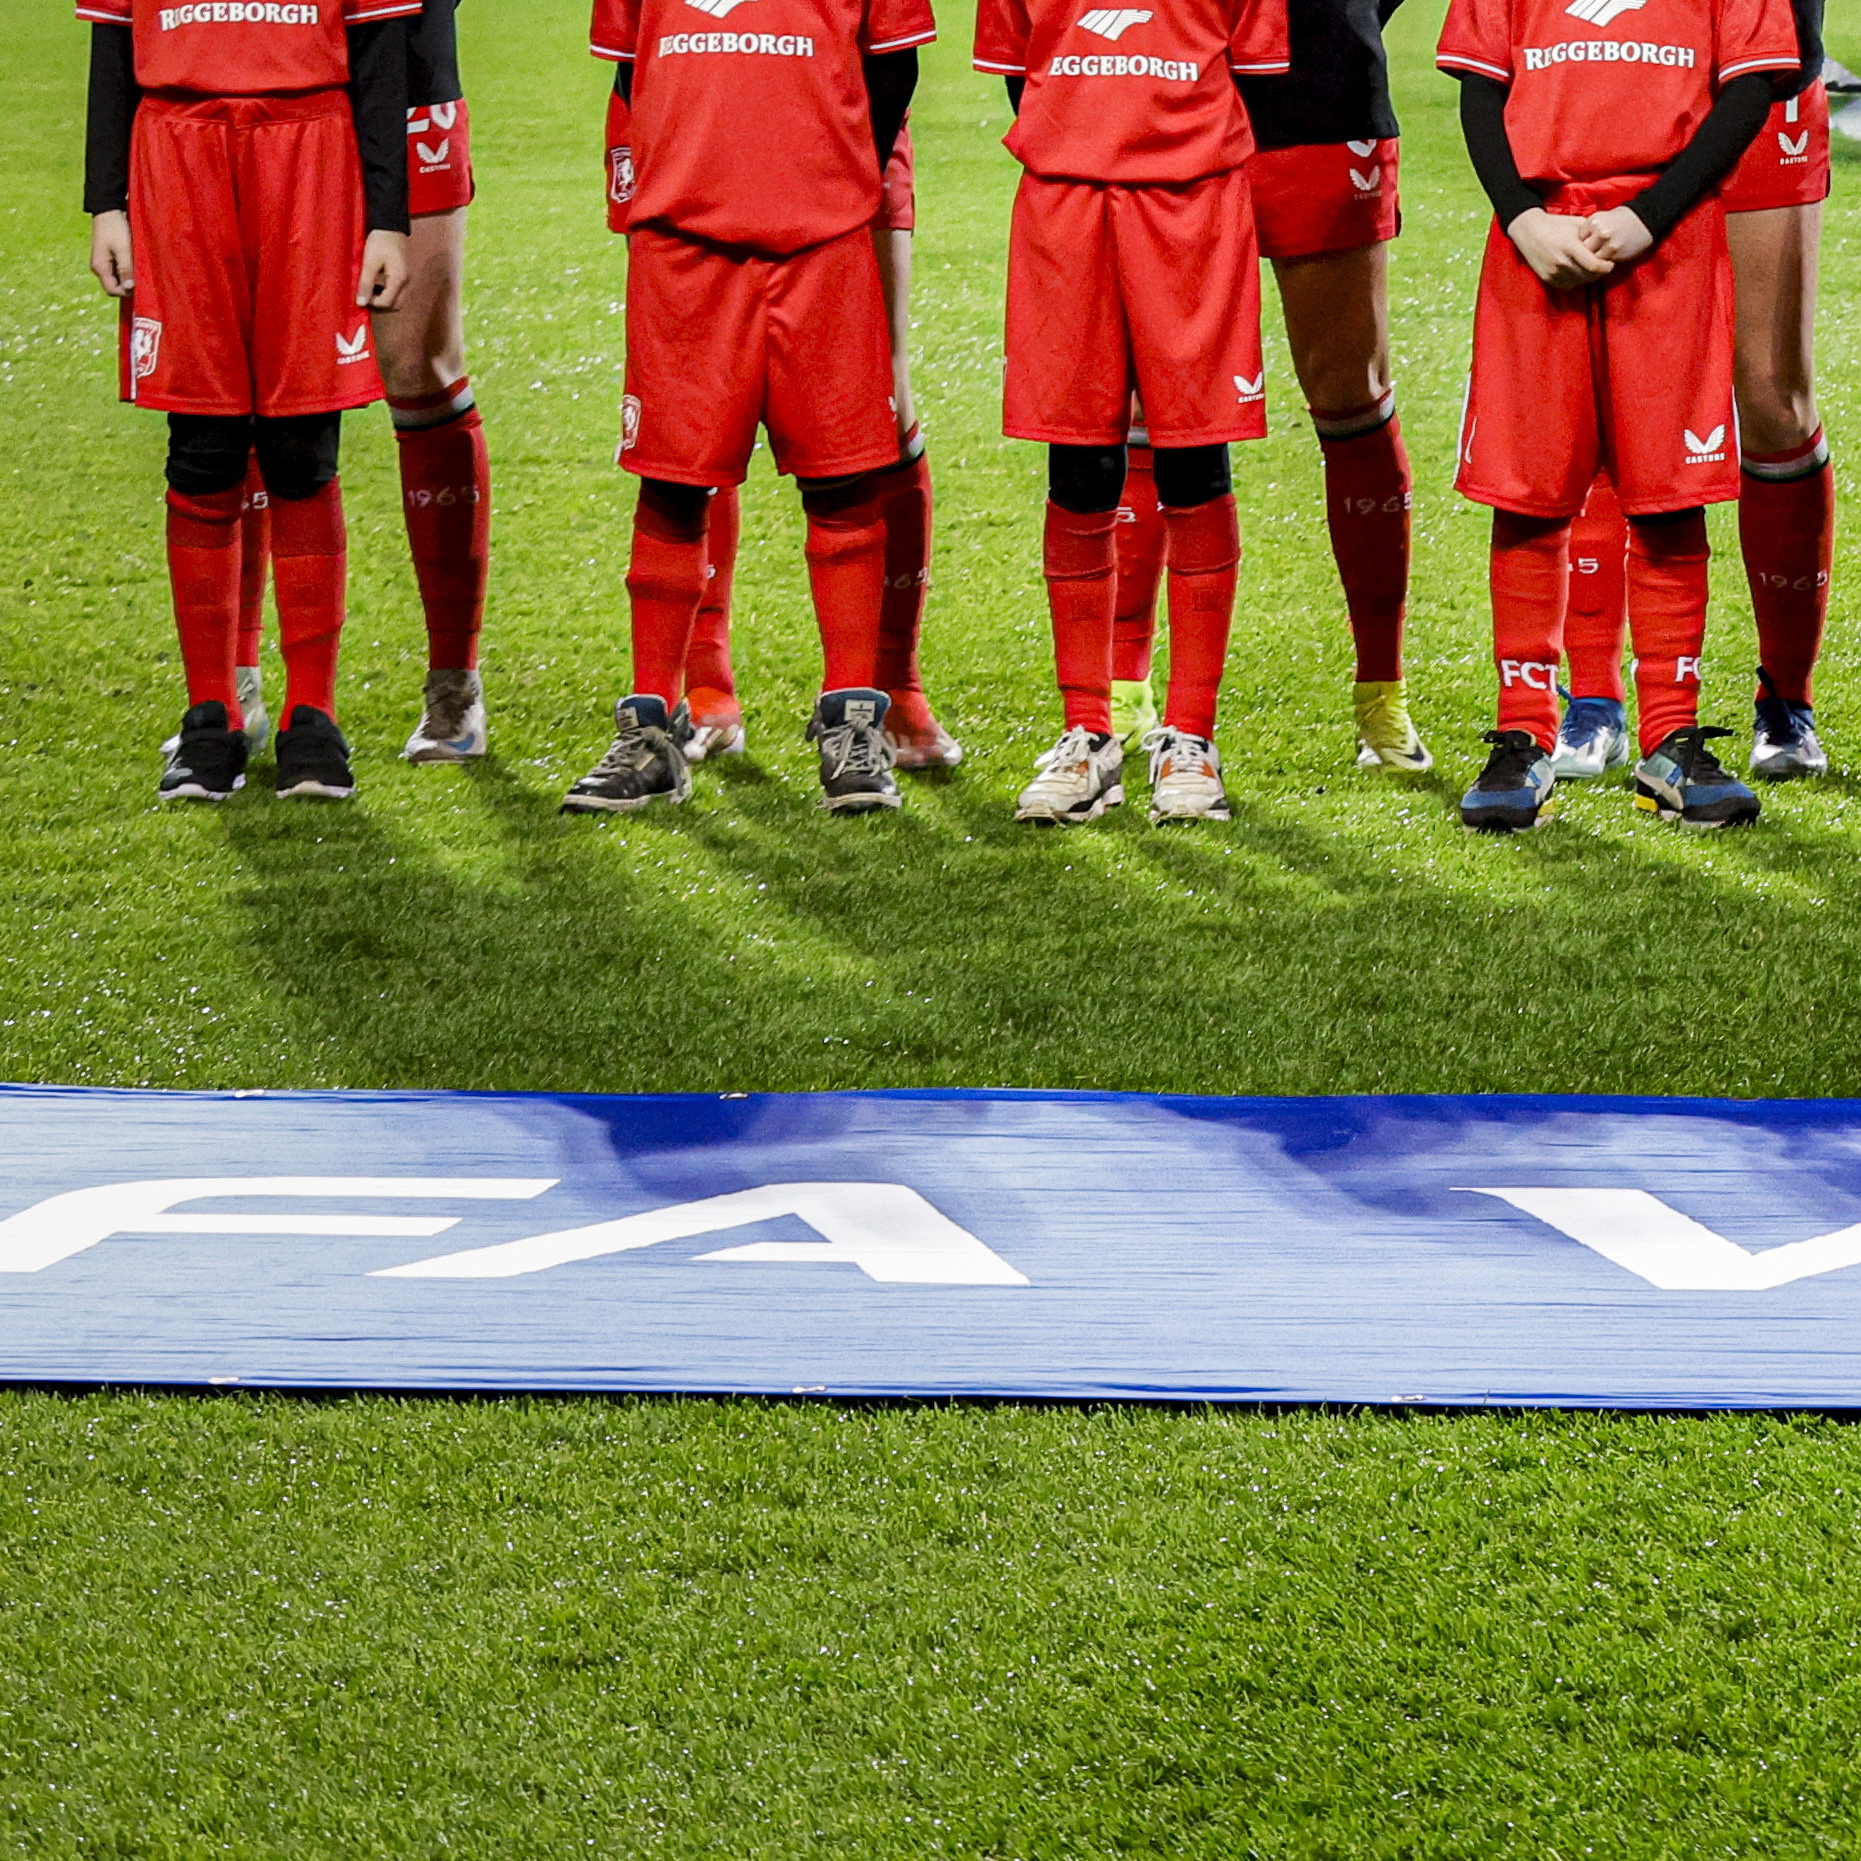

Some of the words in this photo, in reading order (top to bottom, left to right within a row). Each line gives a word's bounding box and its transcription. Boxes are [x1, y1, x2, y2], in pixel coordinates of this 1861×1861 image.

[658, 32, 814, 58] EGGEBORGH
[1049, 55, 1199, 81] EGGEBORGH
[1501, 659, 1558, 696] FCT
